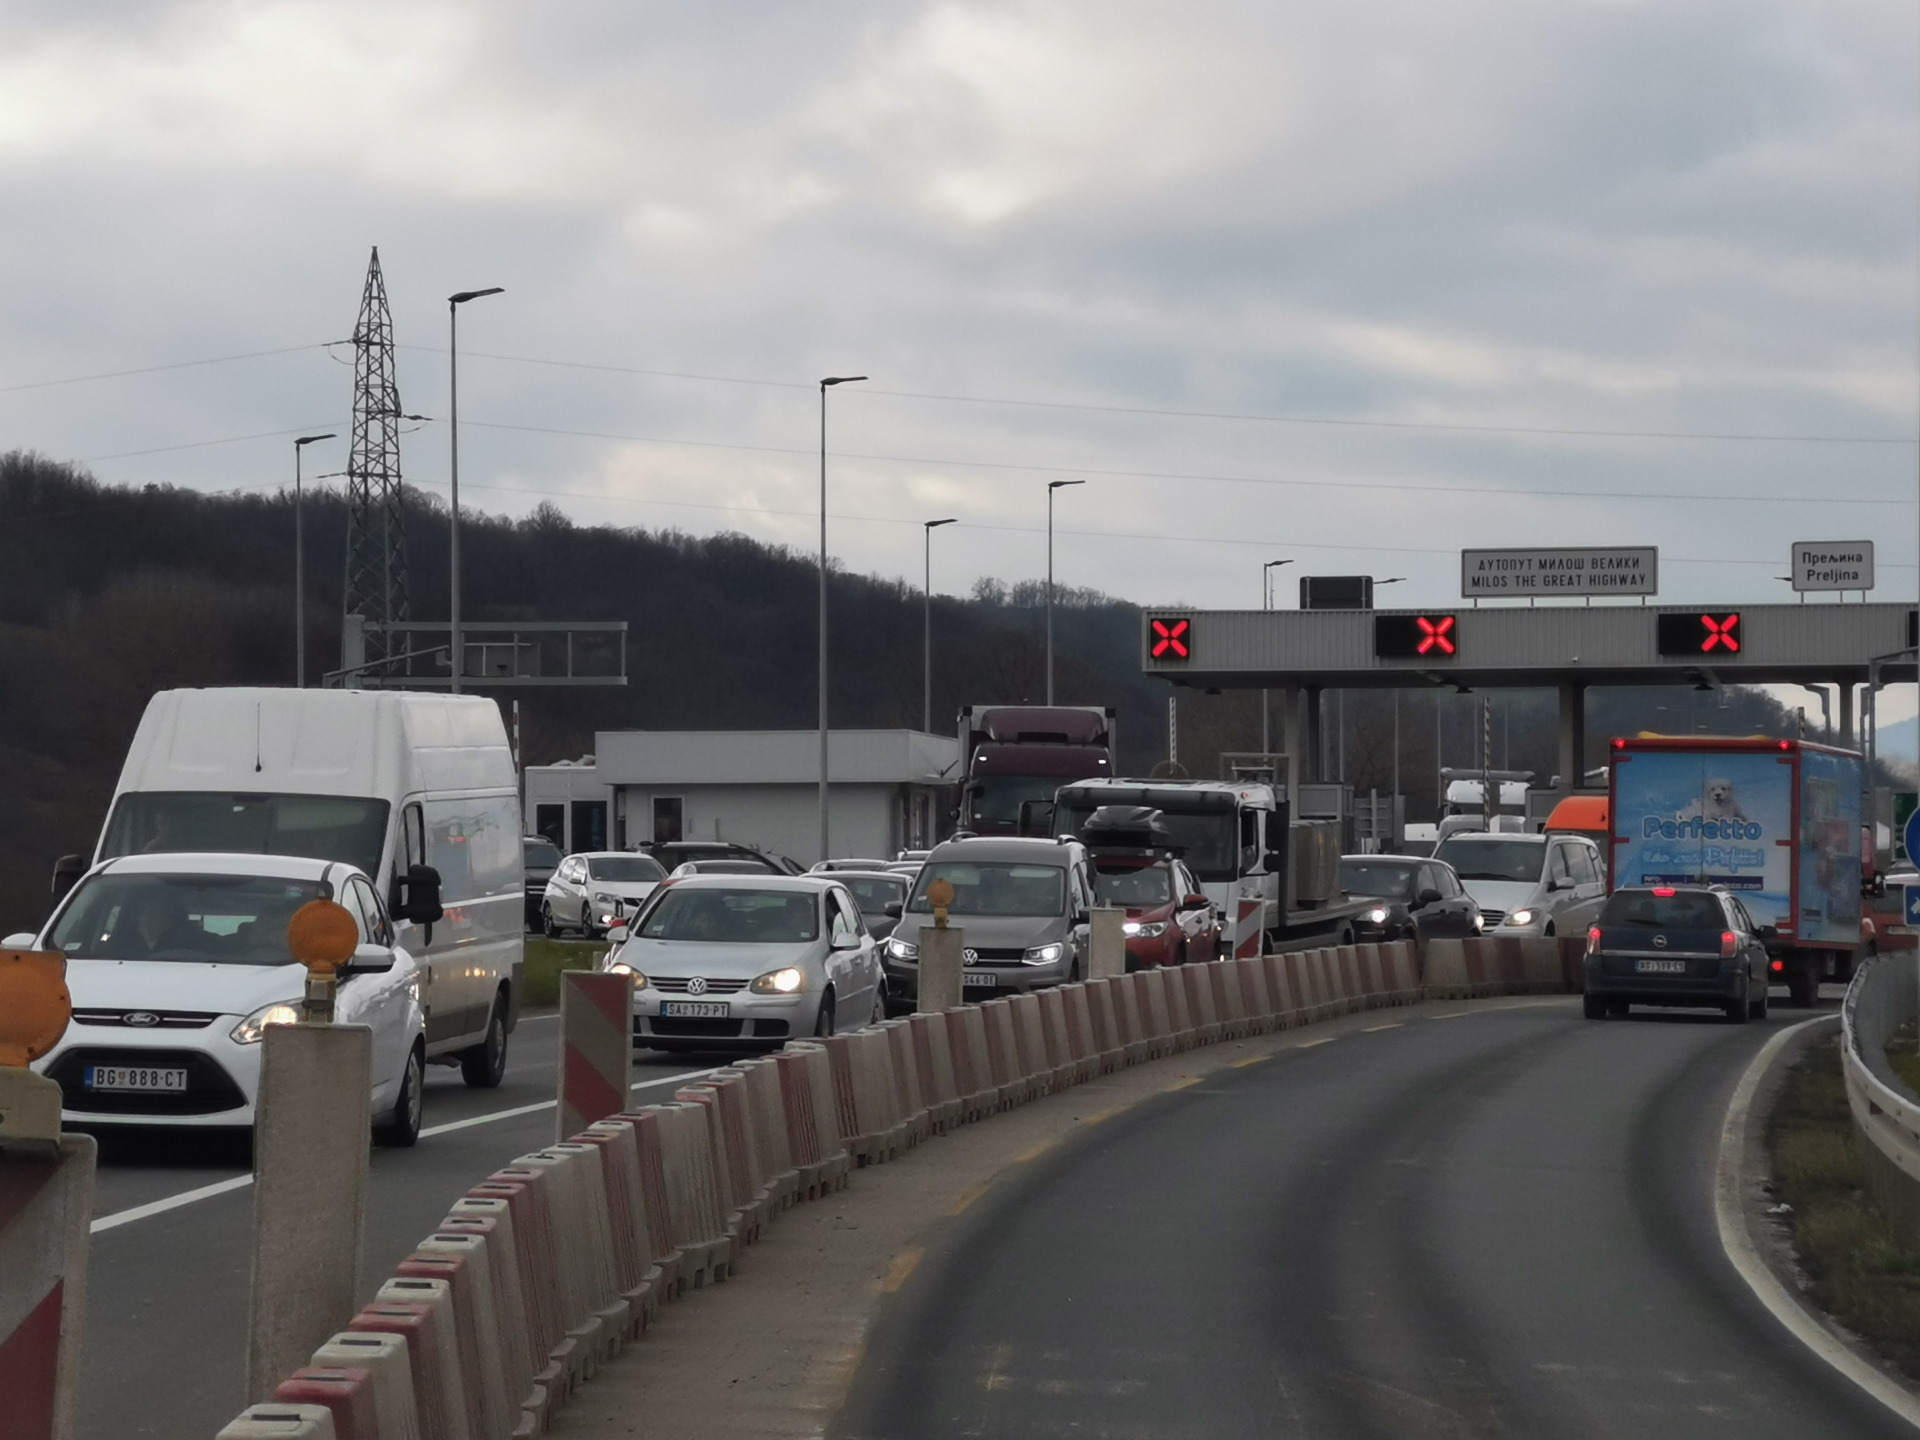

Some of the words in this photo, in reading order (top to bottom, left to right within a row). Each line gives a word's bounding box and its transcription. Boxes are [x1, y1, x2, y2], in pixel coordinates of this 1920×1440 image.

[1478, 557, 1533, 571] АУТОПУТ
[1538, 557, 1585, 571] МИЛОШ
[1591, 556, 1640, 570] ВЕЛИКИ
[1802, 551, 1863, 566] Прељина
[1471, 574, 1508, 588] MILOS
[1515, 574, 1537, 587] THE
[1543, 573, 1583, 587] GREAT
[1589, 572, 1646, 587] HIGHWAY
[1806, 568, 1859, 584] Preljina
[1643, 815, 1762, 841] Perfetto
